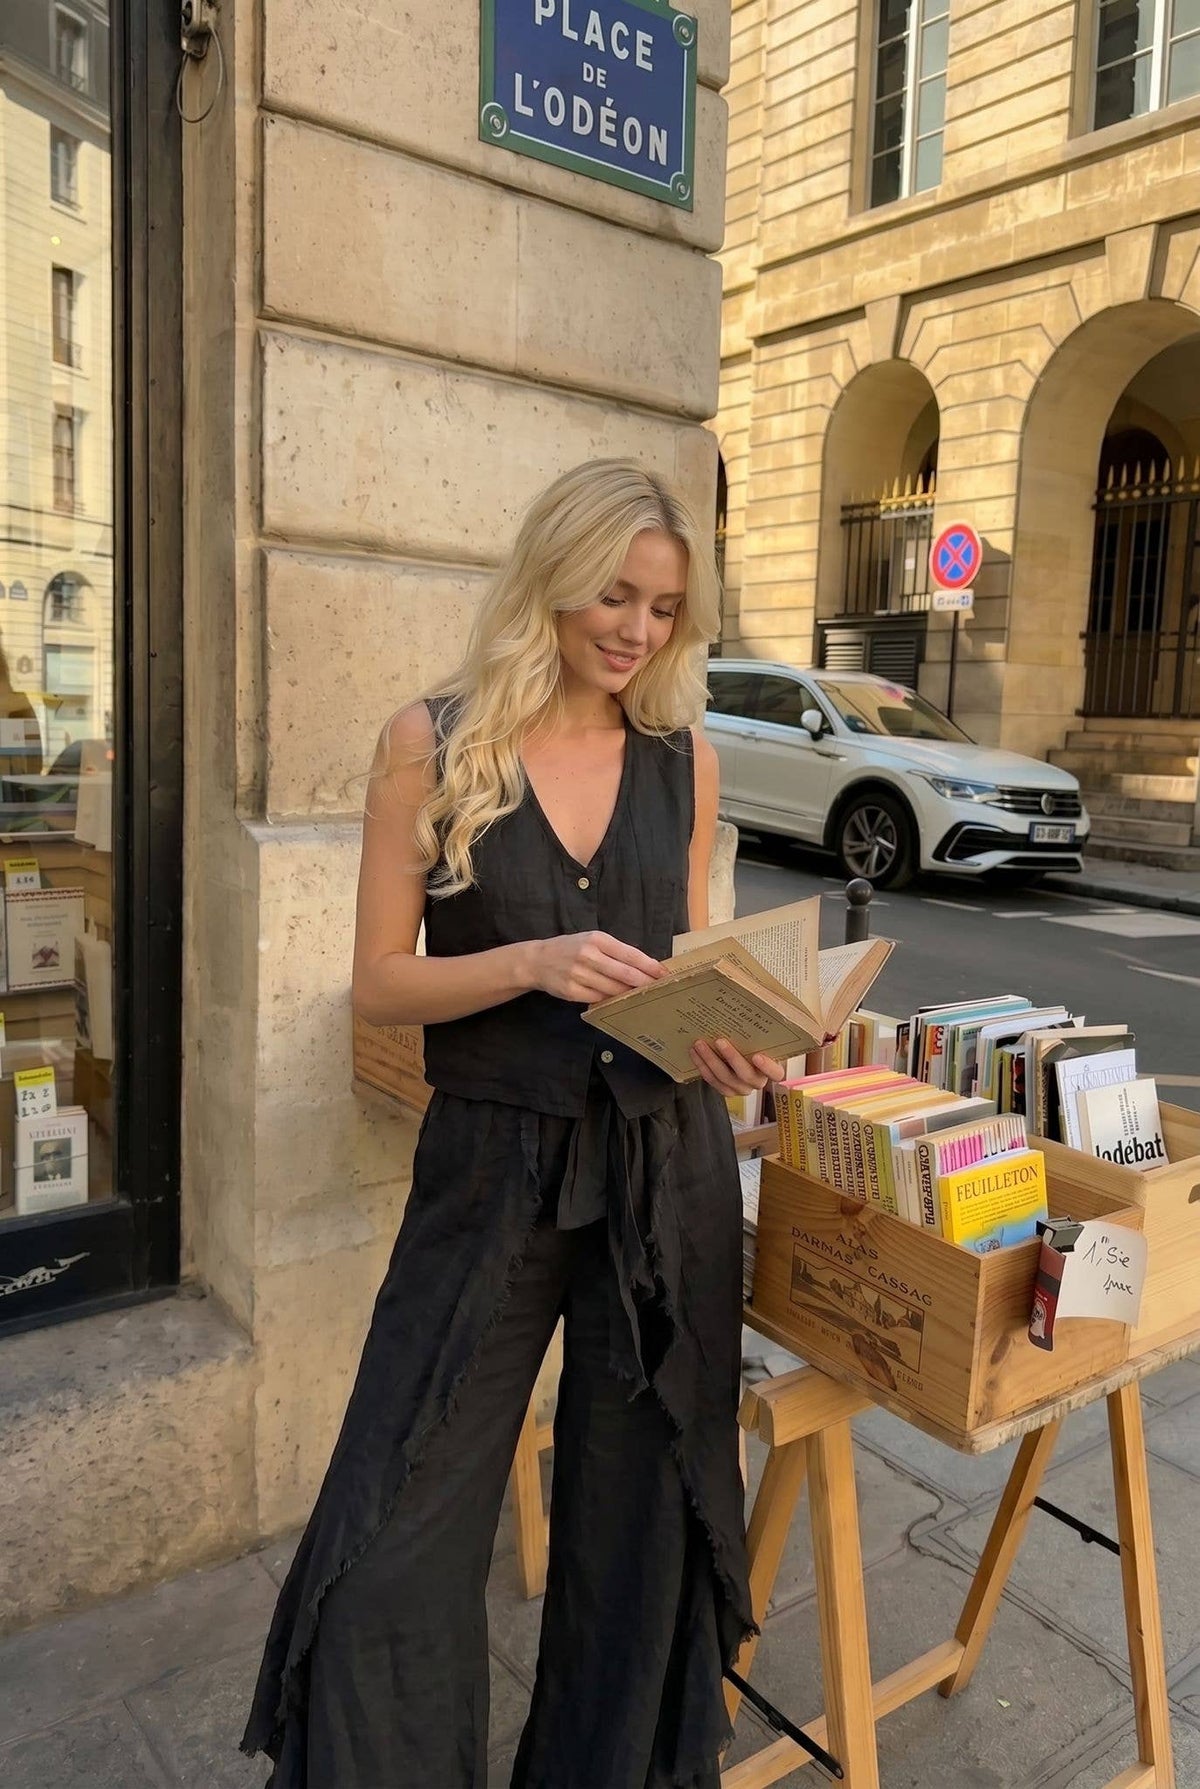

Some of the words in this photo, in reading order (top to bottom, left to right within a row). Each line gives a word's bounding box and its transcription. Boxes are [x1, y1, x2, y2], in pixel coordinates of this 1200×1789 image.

[535, 0, 653, 72] PLACE
[583, 62, 607, 88] DE
[514, 72, 668, 166] L'ODÉON
[956, 1164, 1039, 1202] FEUILLETON
